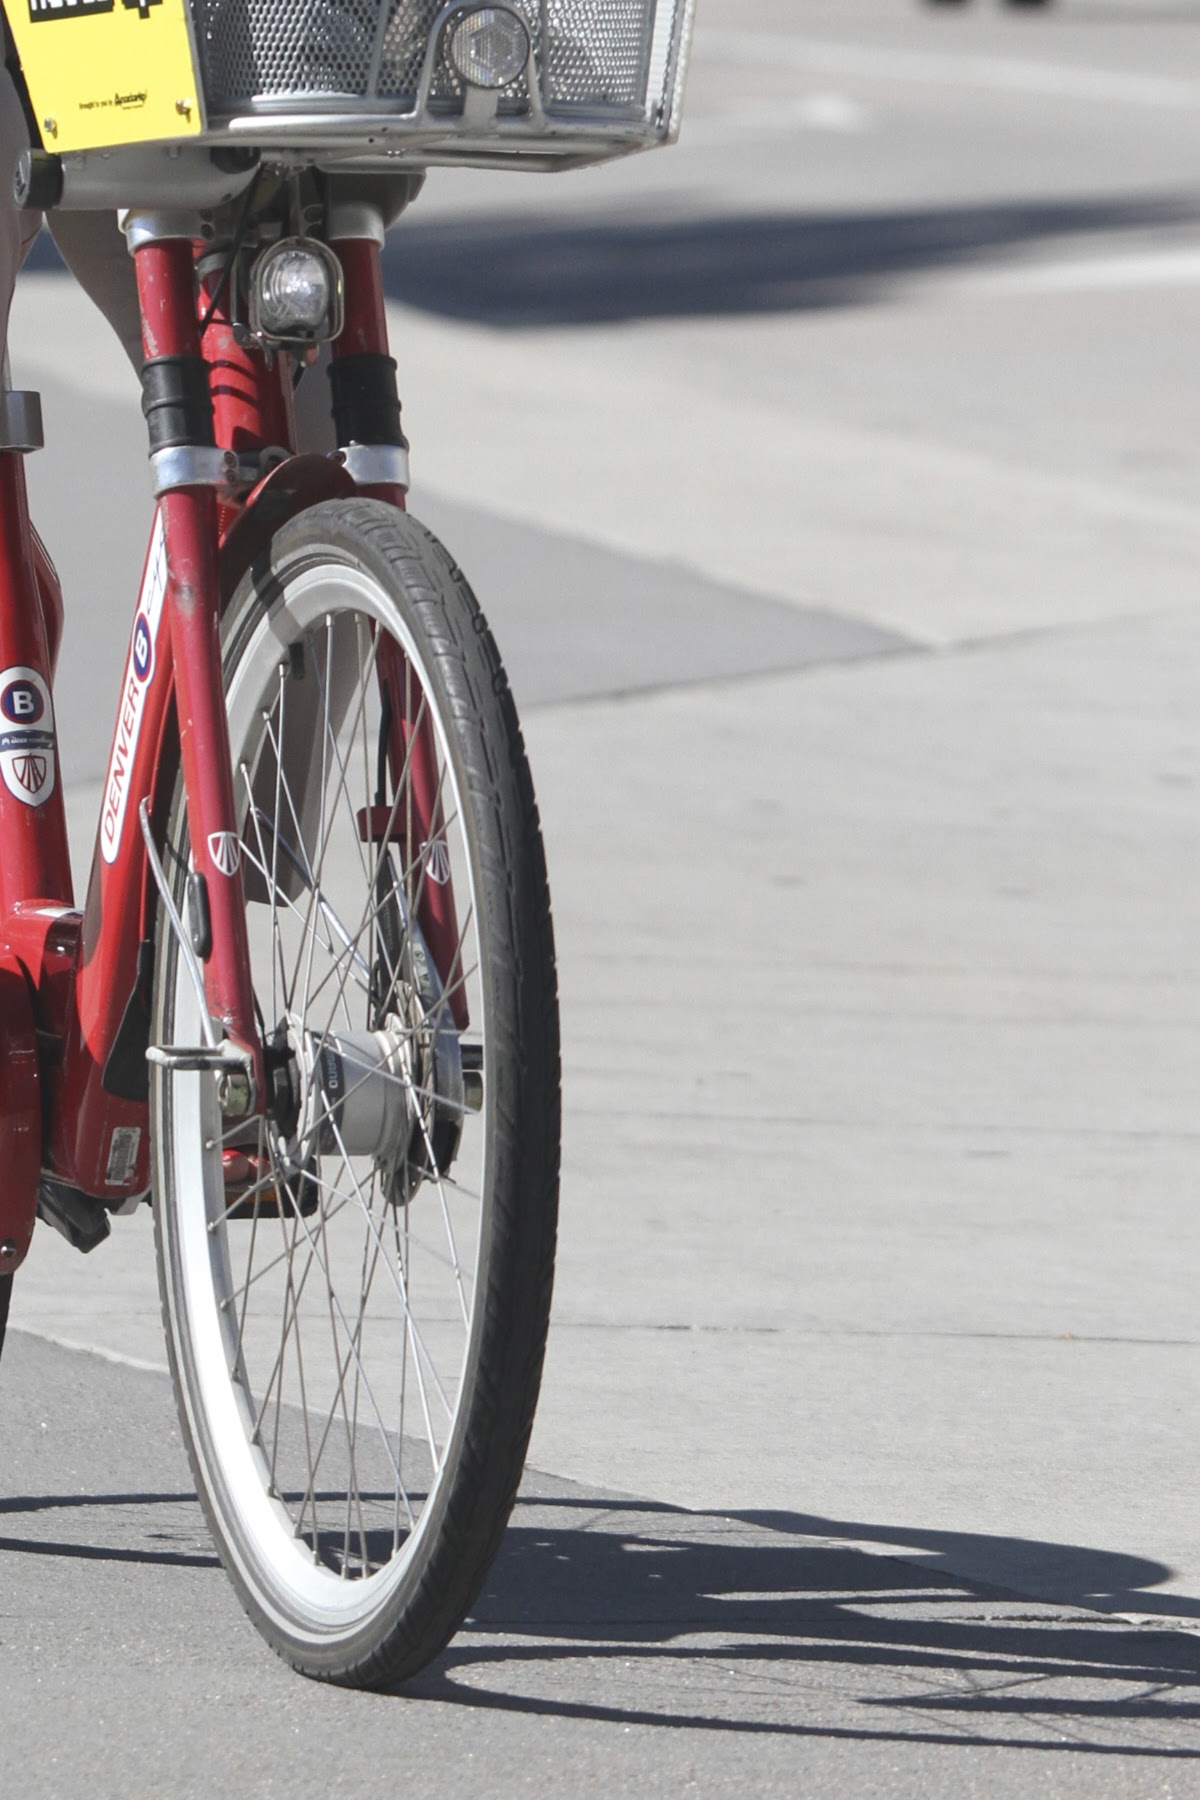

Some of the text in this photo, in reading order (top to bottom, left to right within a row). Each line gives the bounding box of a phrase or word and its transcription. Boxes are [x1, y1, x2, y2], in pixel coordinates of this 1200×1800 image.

[12, 690, 35, 715] B
[104, 677, 139, 845] DENVER
[135, 629, 148, 668] B
